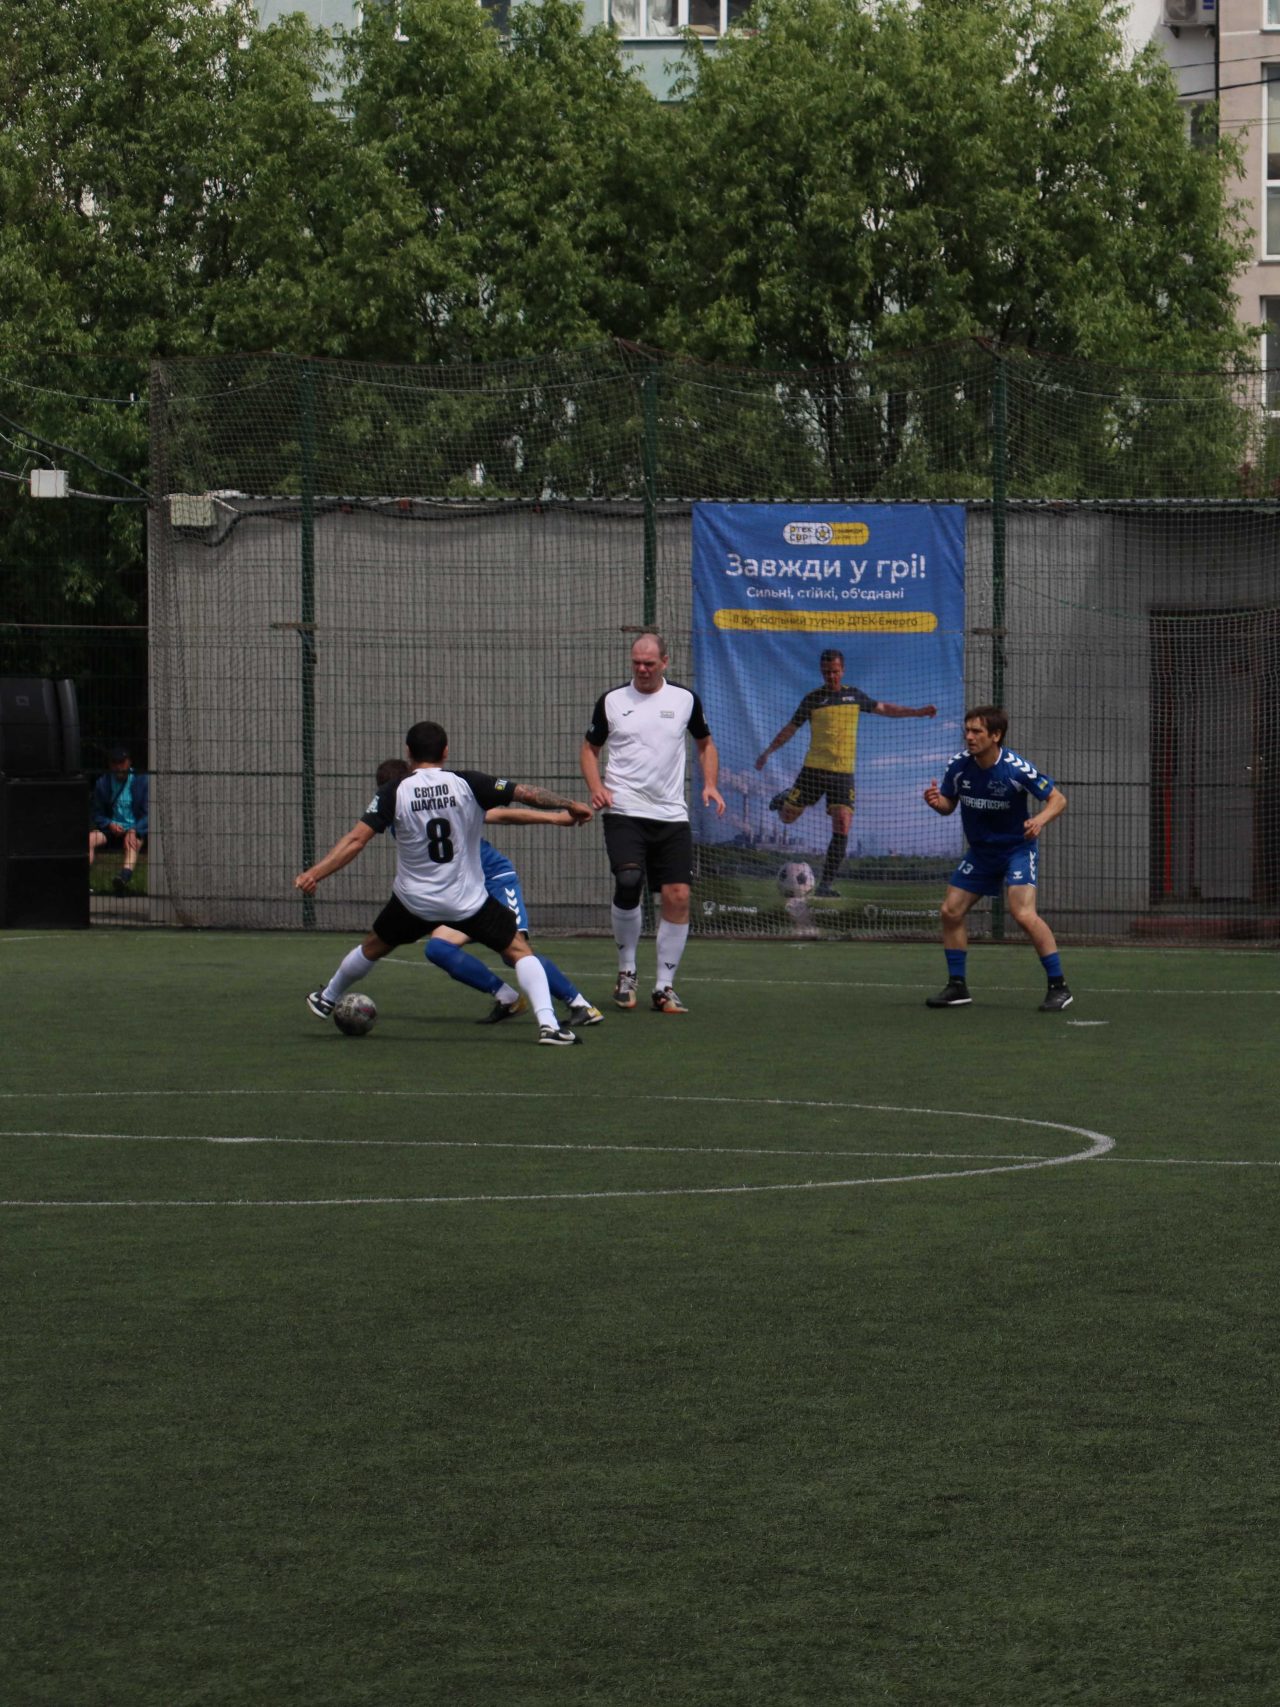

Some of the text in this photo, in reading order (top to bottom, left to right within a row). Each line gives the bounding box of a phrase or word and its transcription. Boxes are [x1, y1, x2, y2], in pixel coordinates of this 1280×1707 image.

[725, 553, 926, 584] Завжди у грі!
[746, 586, 794, 601] Сильні,
[797, 586, 838, 600] стійкі,
[414, 784, 449, 798] СВІТЛО
[411, 796, 456, 812] ШАХТАРЯ
[426, 818, 454, 864] 8
[957, 859, 974, 875] 13
